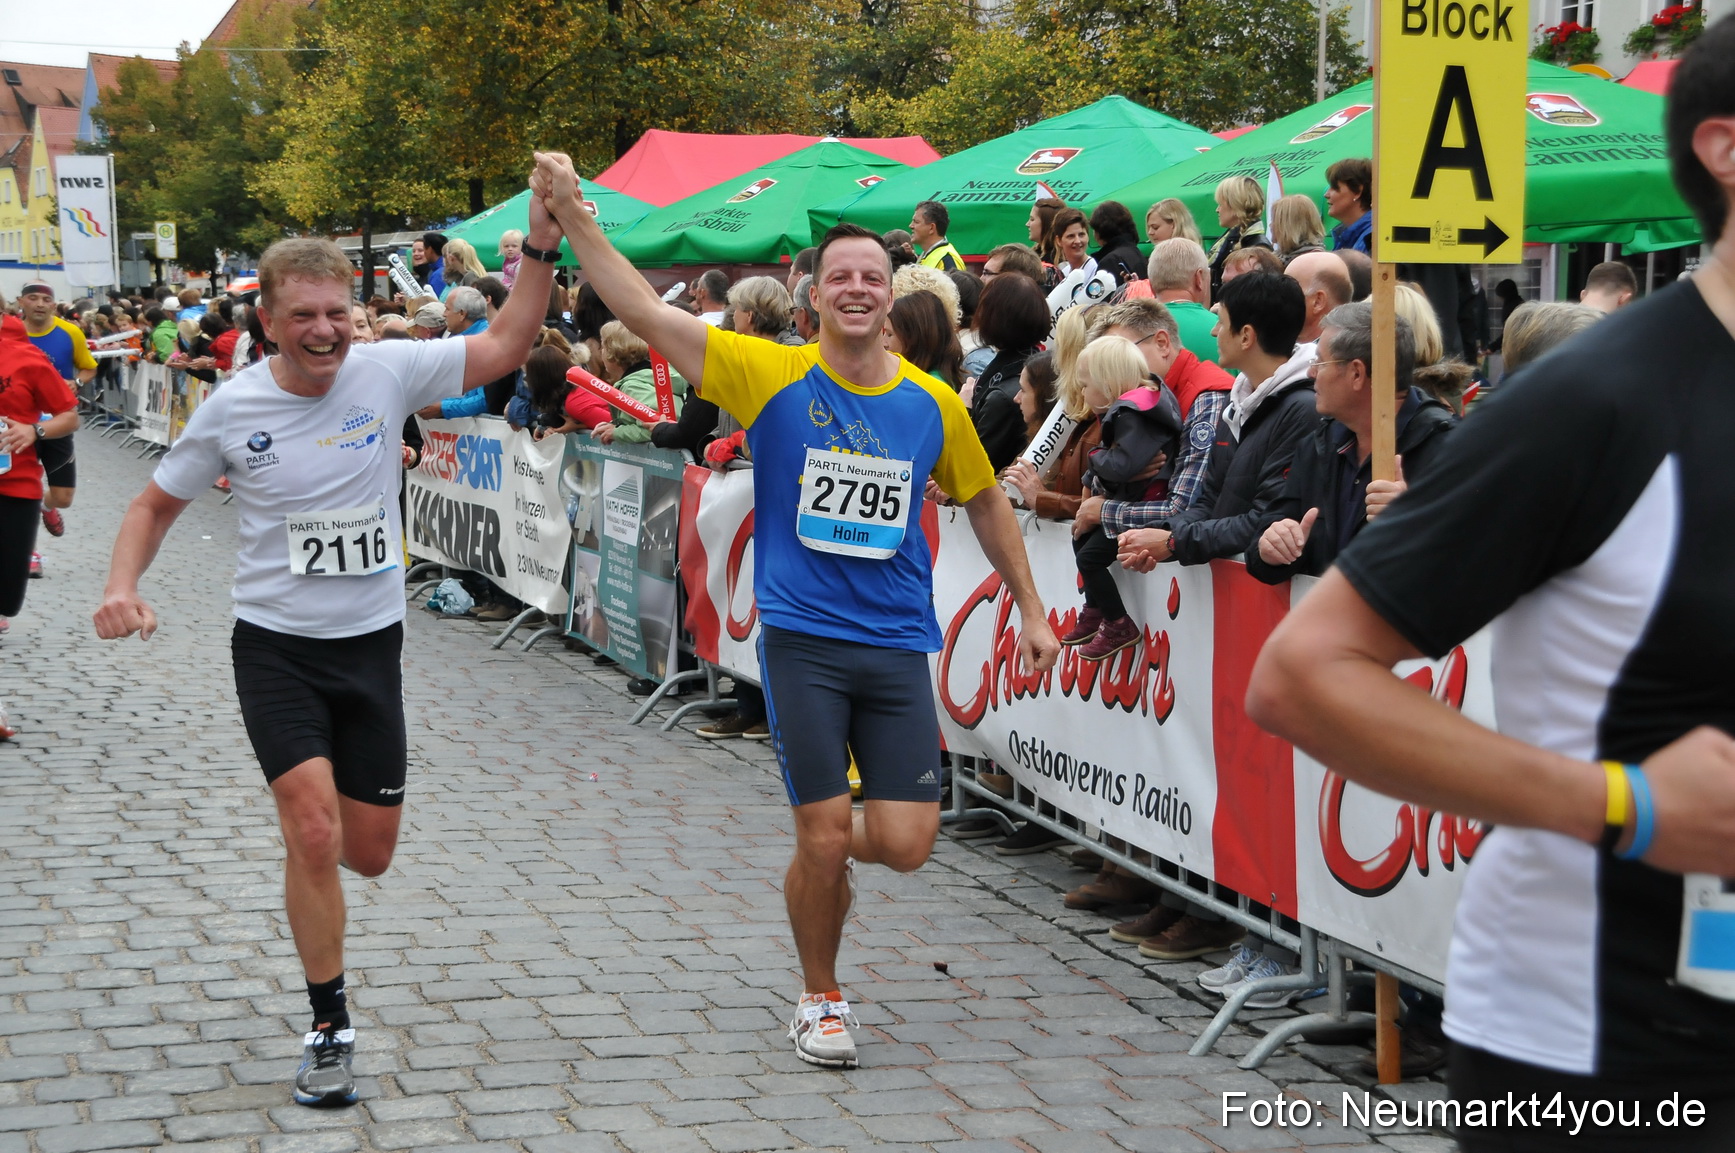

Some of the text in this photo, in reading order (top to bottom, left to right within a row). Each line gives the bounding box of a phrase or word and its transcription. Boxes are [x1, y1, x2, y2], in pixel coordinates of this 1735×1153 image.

[1401, 0, 1513, 42] Block
[1410, 65, 1494, 202] A
[1525, 132, 1666, 150] Neumarkte
[928, 189, 1090, 203] Lammsbäu
[615, 391, 657, 418] Audi BKK
[660, 393, 671, 414] BKK
[246, 452, 279, 465] PARTL
[248, 459, 280, 471] Neumarkt
[417, 429, 503, 492] NTERSPORT
[808, 458, 897, 480] PARTL Neumarkt
[811, 476, 902, 521] 2795
[619, 503, 639, 518] HOFFER
[290, 513, 378, 533] PARTL Neumarkt
[833, 524, 870, 543] Holm
[302, 526, 387, 575] 2116
[1008, 729, 1193, 836] Ostbayerns Radio
